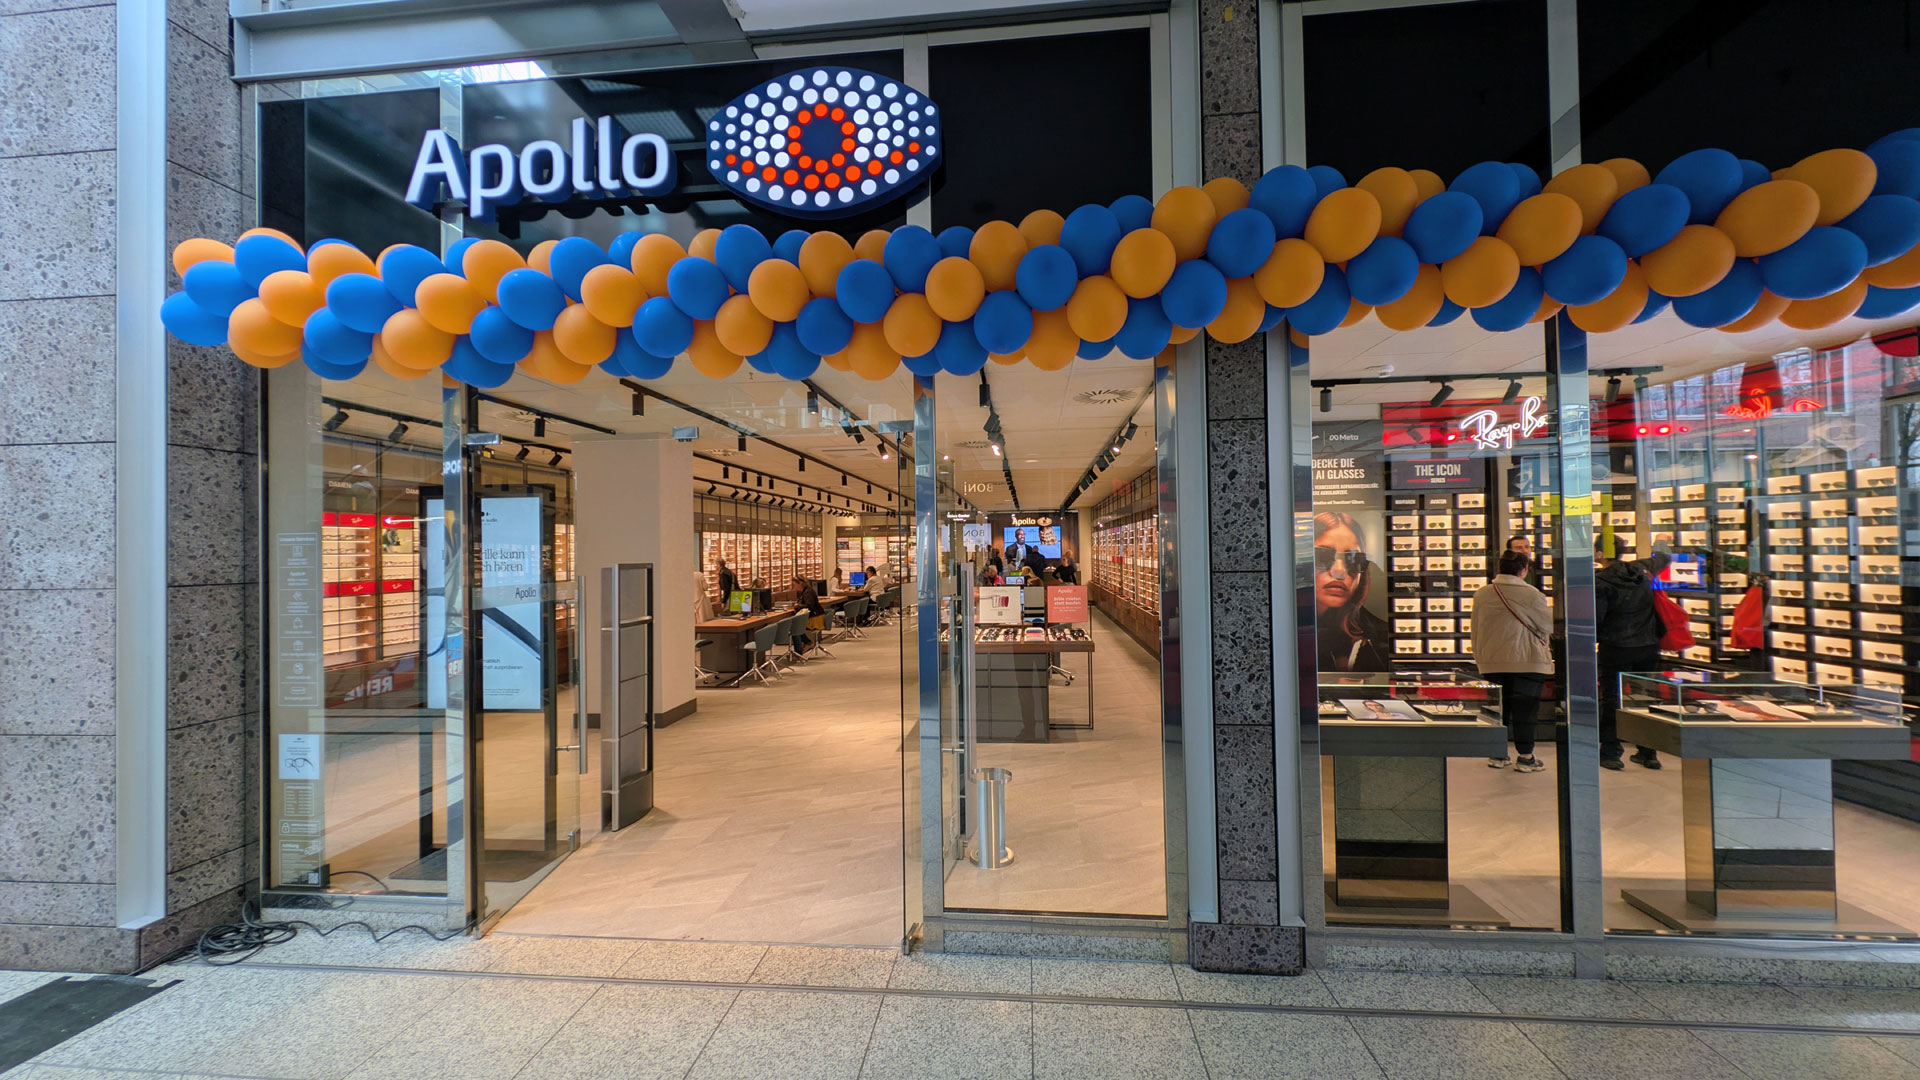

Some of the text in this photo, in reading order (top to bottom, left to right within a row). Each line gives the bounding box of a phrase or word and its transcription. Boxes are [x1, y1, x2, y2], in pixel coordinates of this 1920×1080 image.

[404, 114, 670, 219] Apollo
[1340, 458, 1355, 468] DIE
[1315, 468, 1366, 480] AI GLASSES
[1414, 464, 1462, 477] THE ICON
[1012, 517, 1036, 526] Apollo
[501, 548, 525, 559] kann
[494, 561, 523, 572] hören
[515, 588, 537, 600] Apollo
